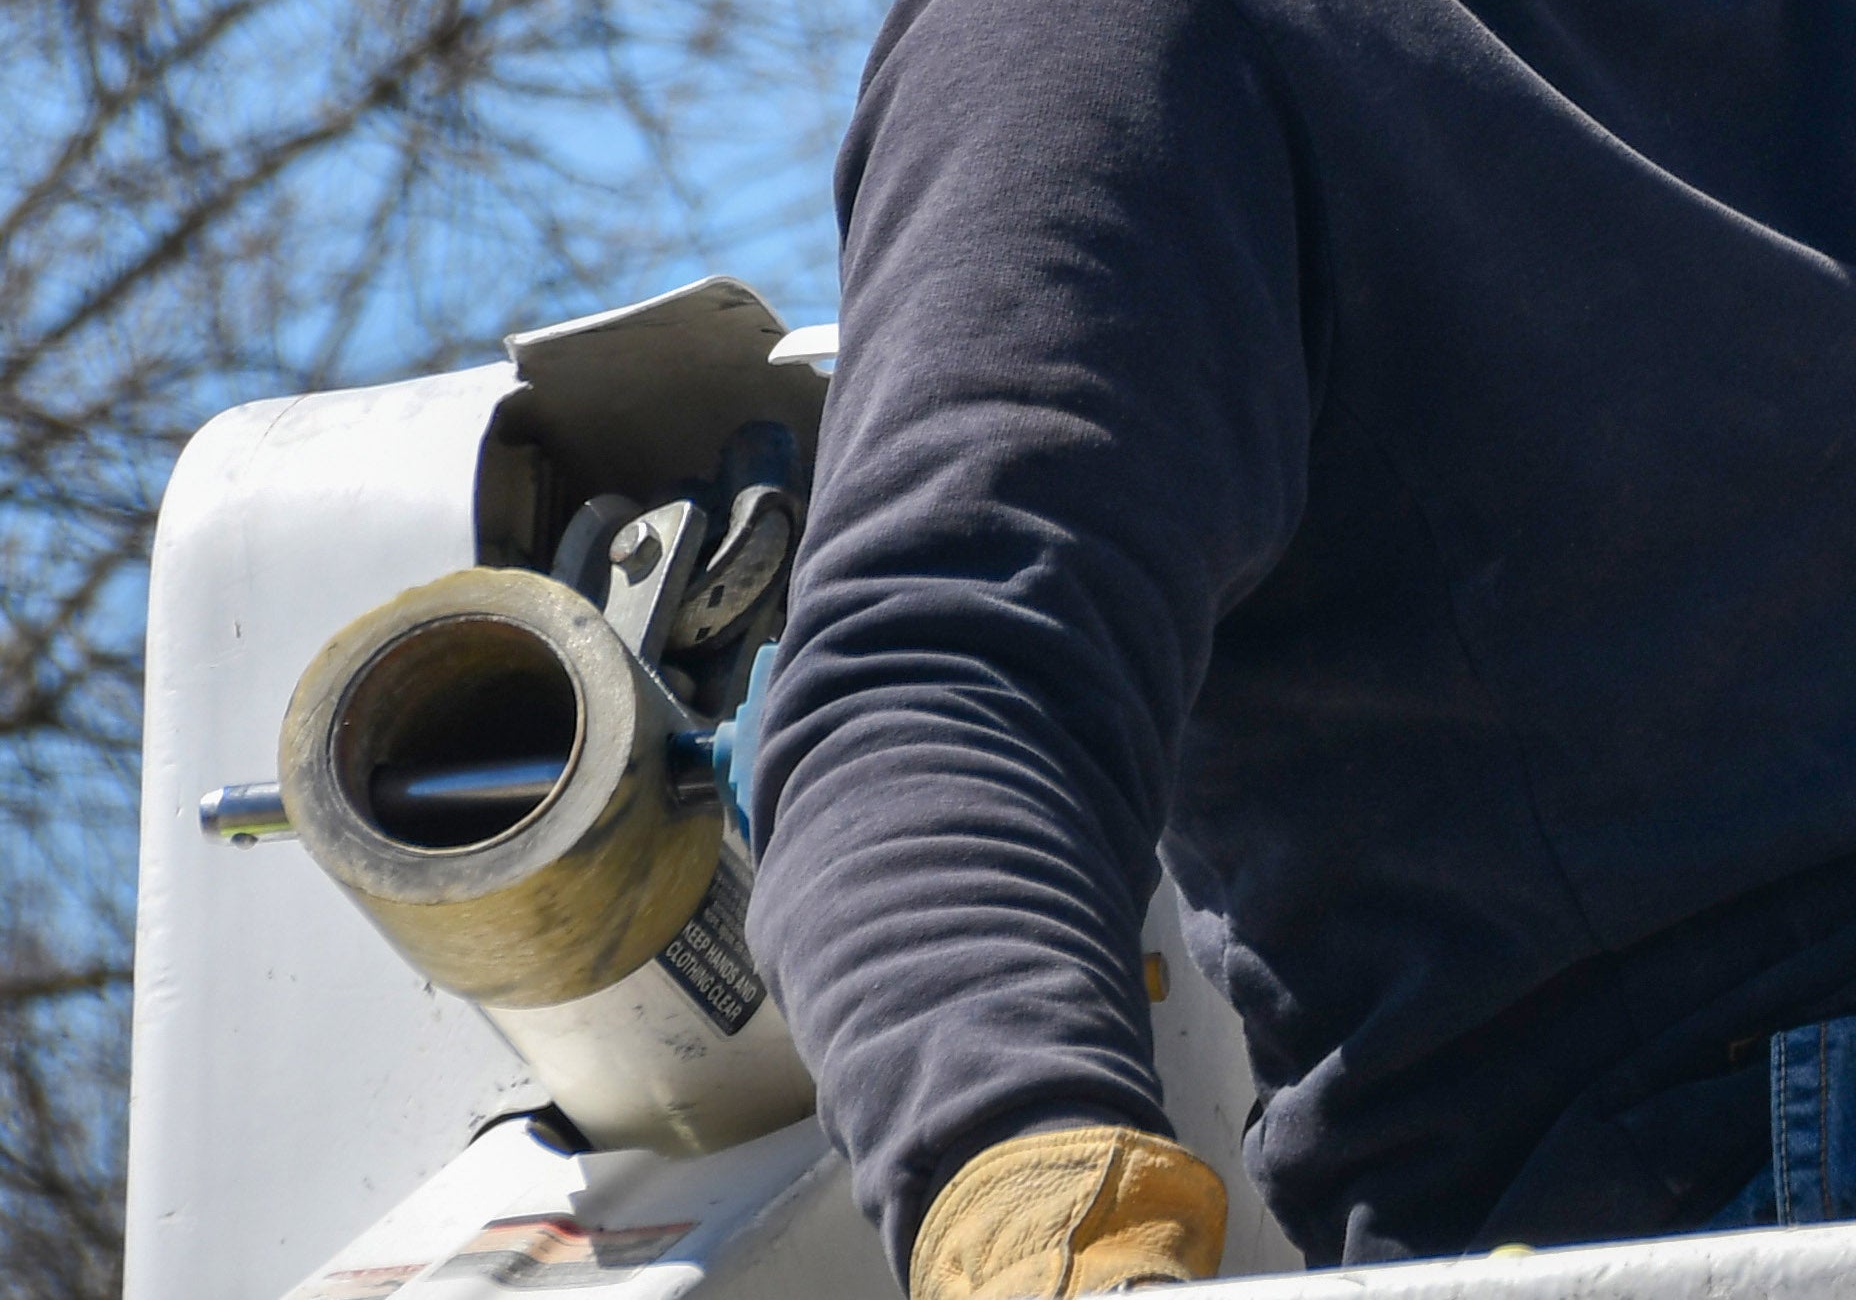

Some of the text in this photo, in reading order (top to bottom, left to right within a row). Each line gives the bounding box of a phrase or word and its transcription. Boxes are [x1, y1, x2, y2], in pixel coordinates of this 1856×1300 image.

[665, 941, 743, 1022] CLOTHING CLEAR
[682, 919, 711, 952] KEEP
[705, 944, 739, 985] HANDS
[733, 974, 757, 1003] AND
